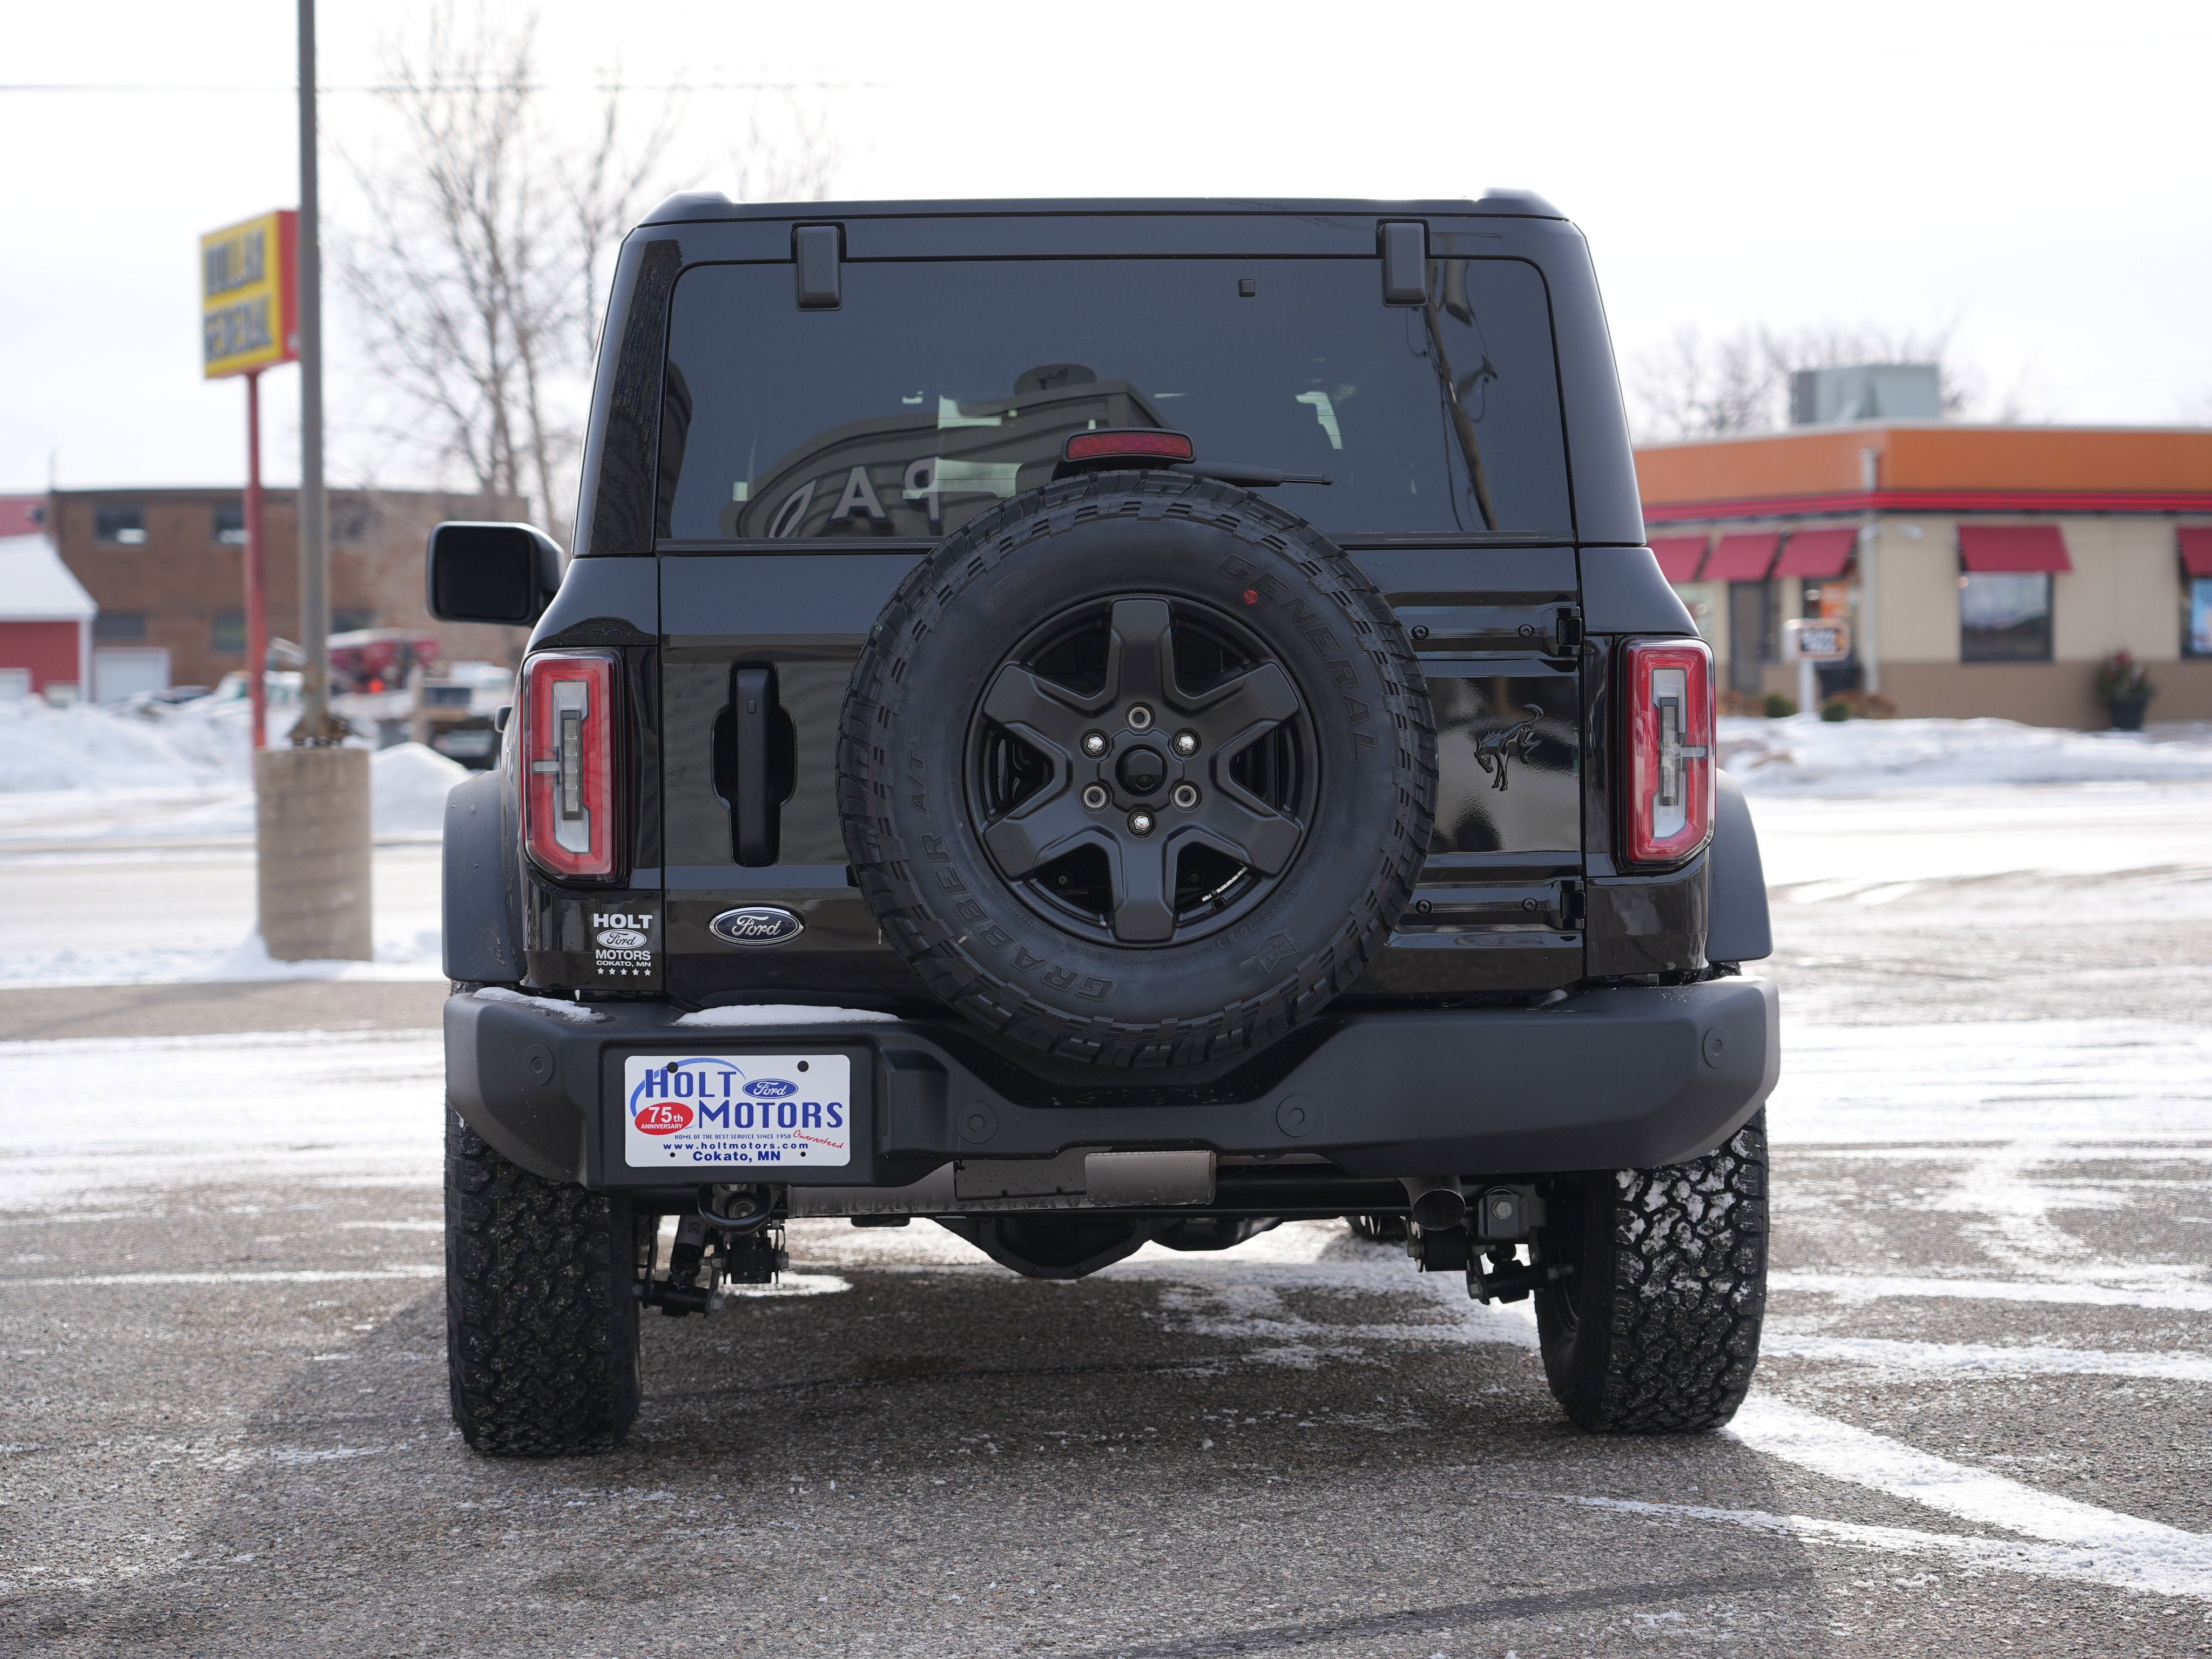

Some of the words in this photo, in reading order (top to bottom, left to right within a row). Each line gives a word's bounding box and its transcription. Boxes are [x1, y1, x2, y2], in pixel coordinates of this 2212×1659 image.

[1218, 554, 1377, 763] GENERAL
[593, 913, 653, 929] HOLT
[731, 915, 782, 936] Ford
[920, 833, 1116, 1002] GRABBER
[606, 932, 636, 946] Ford
[596, 949, 651, 961] MOTORS
[645, 1069, 737, 1098] HOLT
[753, 1081, 787, 1096] Ford
[648, 1107, 684, 1123] 75th
[698, 1100, 843, 1129] MOTORS
[663, 1142, 808, 1150] www.holtmotors.com
[793, 1130, 844, 1149] Guaranteed
[693, 1151, 752, 1163] Cokato,
[758, 1151, 781, 1161] MN
